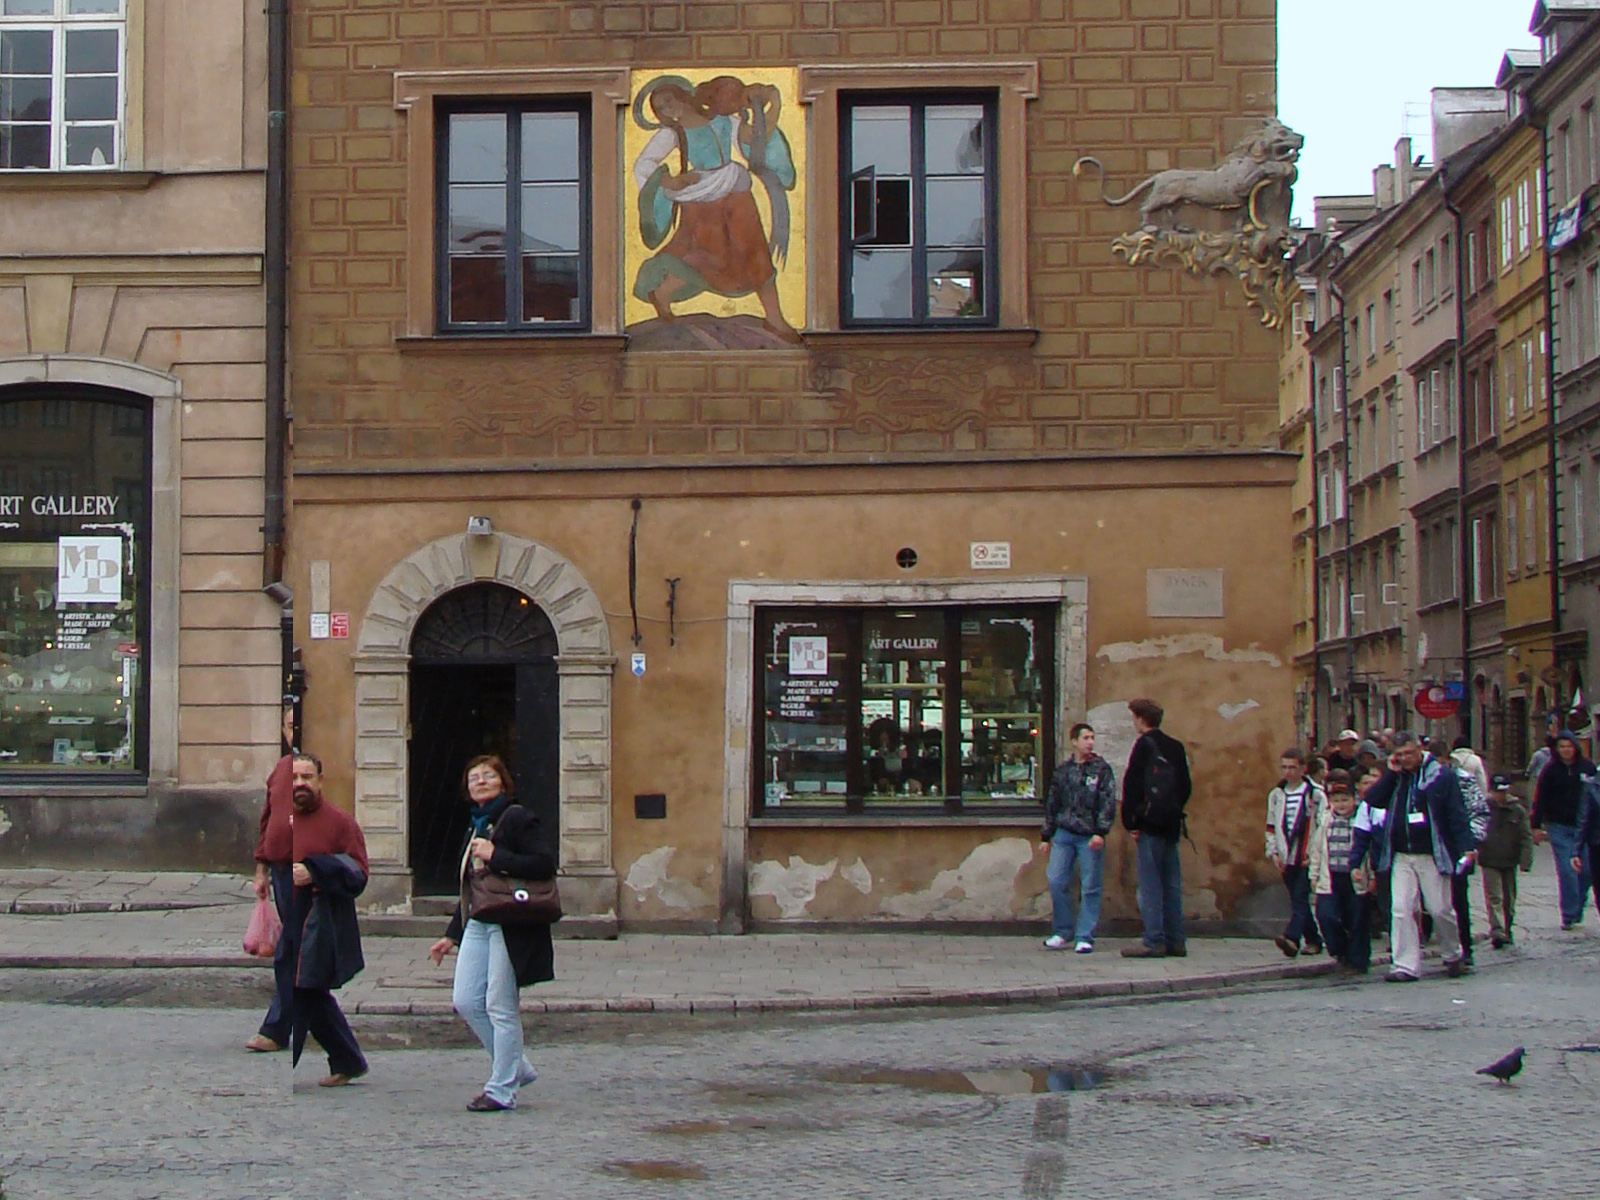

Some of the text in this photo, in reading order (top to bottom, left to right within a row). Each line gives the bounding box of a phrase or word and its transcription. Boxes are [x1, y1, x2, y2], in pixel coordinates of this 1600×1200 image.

[0, 495, 119, 515] RT GALLERY
[869, 638, 939, 649] ART GALLERY
